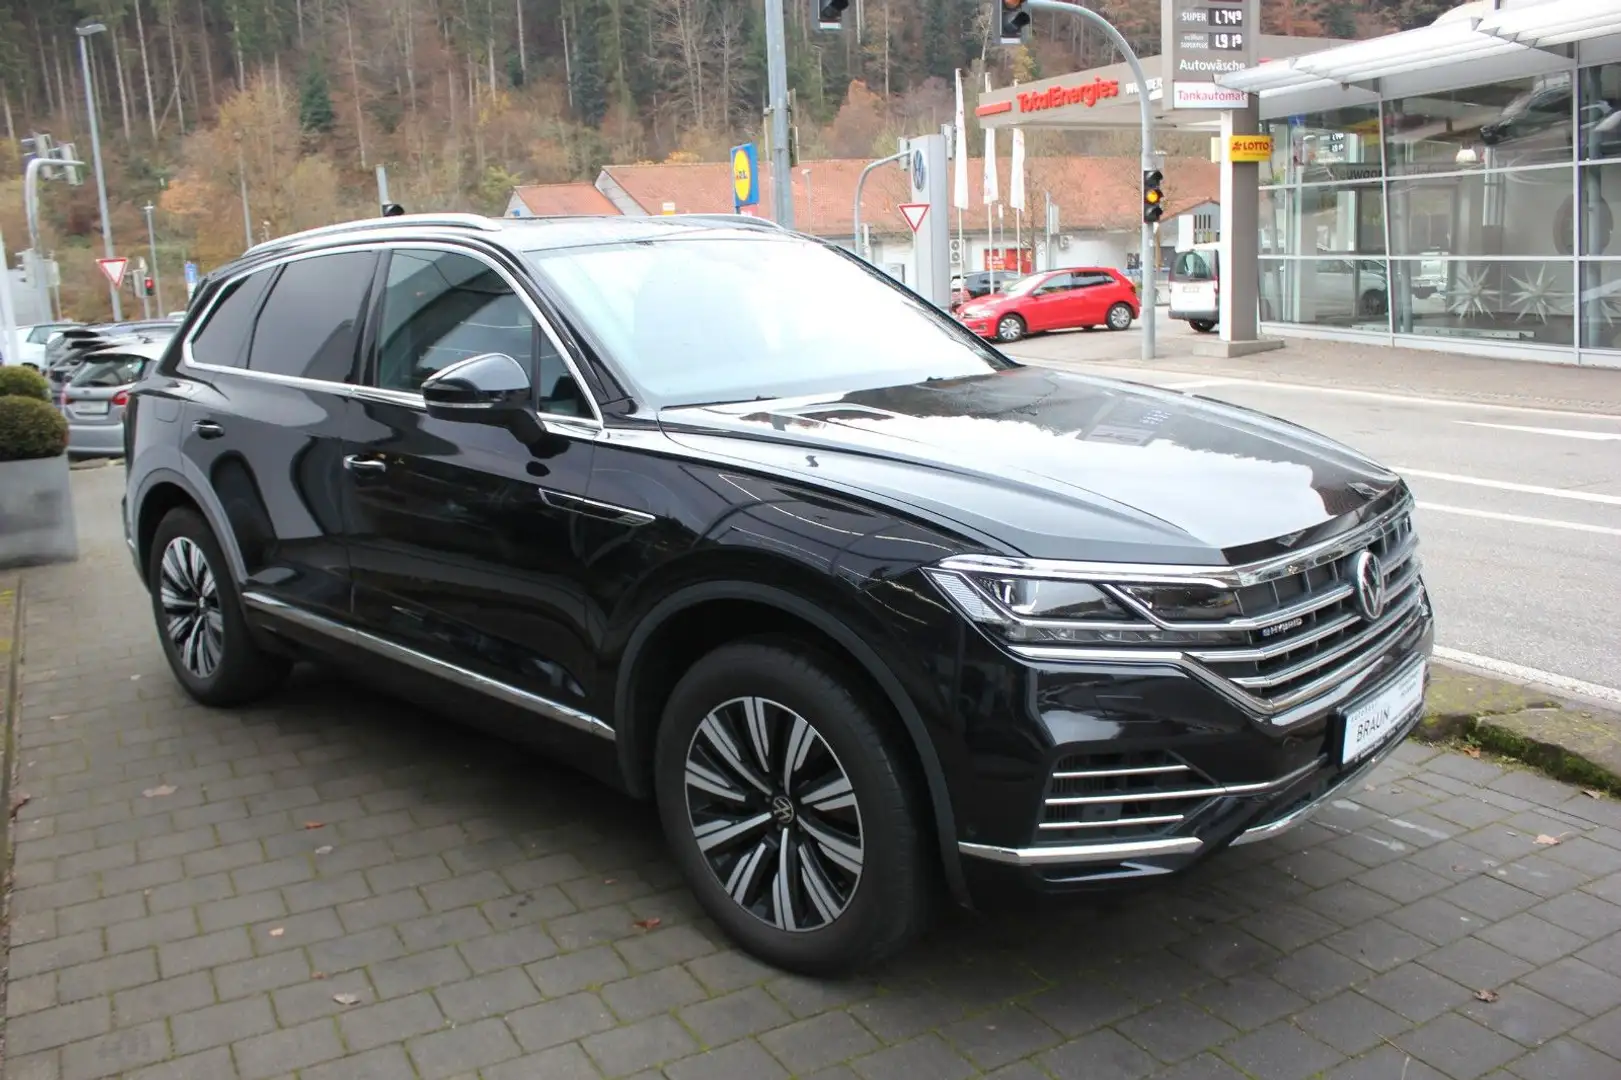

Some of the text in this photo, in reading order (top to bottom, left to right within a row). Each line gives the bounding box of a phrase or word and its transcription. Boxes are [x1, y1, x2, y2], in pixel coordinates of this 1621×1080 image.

[1182, 12, 1207, 22] SUPER
[1179, 59, 1246, 71] Autowäsche
[1016, 75, 1119, 112] TotalEnergies
[1178, 91, 1246, 101] Tankautomat
[1243, 142, 1269, 151] LOTTO
[1356, 704, 1390, 742] BRAUN
